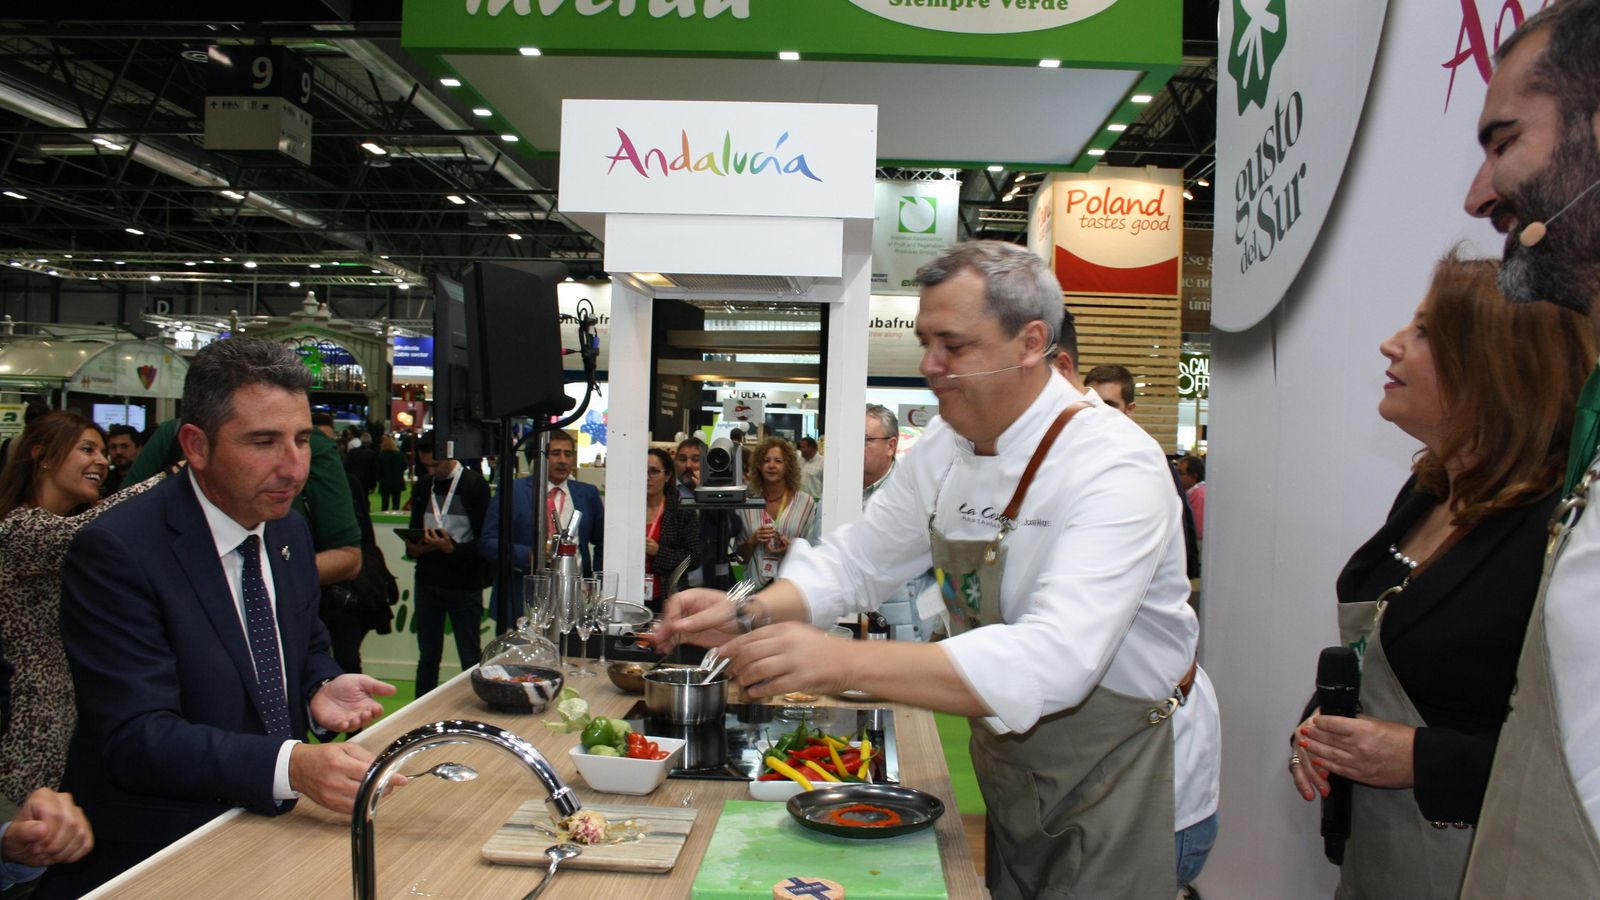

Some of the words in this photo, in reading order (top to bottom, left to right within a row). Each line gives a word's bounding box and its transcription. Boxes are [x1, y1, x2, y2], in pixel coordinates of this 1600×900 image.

[252, 56, 273, 90] 9
[300, 72, 311, 104] 9
[605, 126, 824, 183] Andalucía
[1235, 91, 1304, 245] gusto
[1066, 186, 1165, 216] Poland
[1079, 213, 1127, 230] tastes
[1129, 214, 1172, 236] good
[1240, 228, 1258, 275] del
[1257, 162, 1307, 263] Sur
[157, 300, 170, 315] D
[740, 391, 767, 400] ULMA
[958, 501, 977, 515] La
